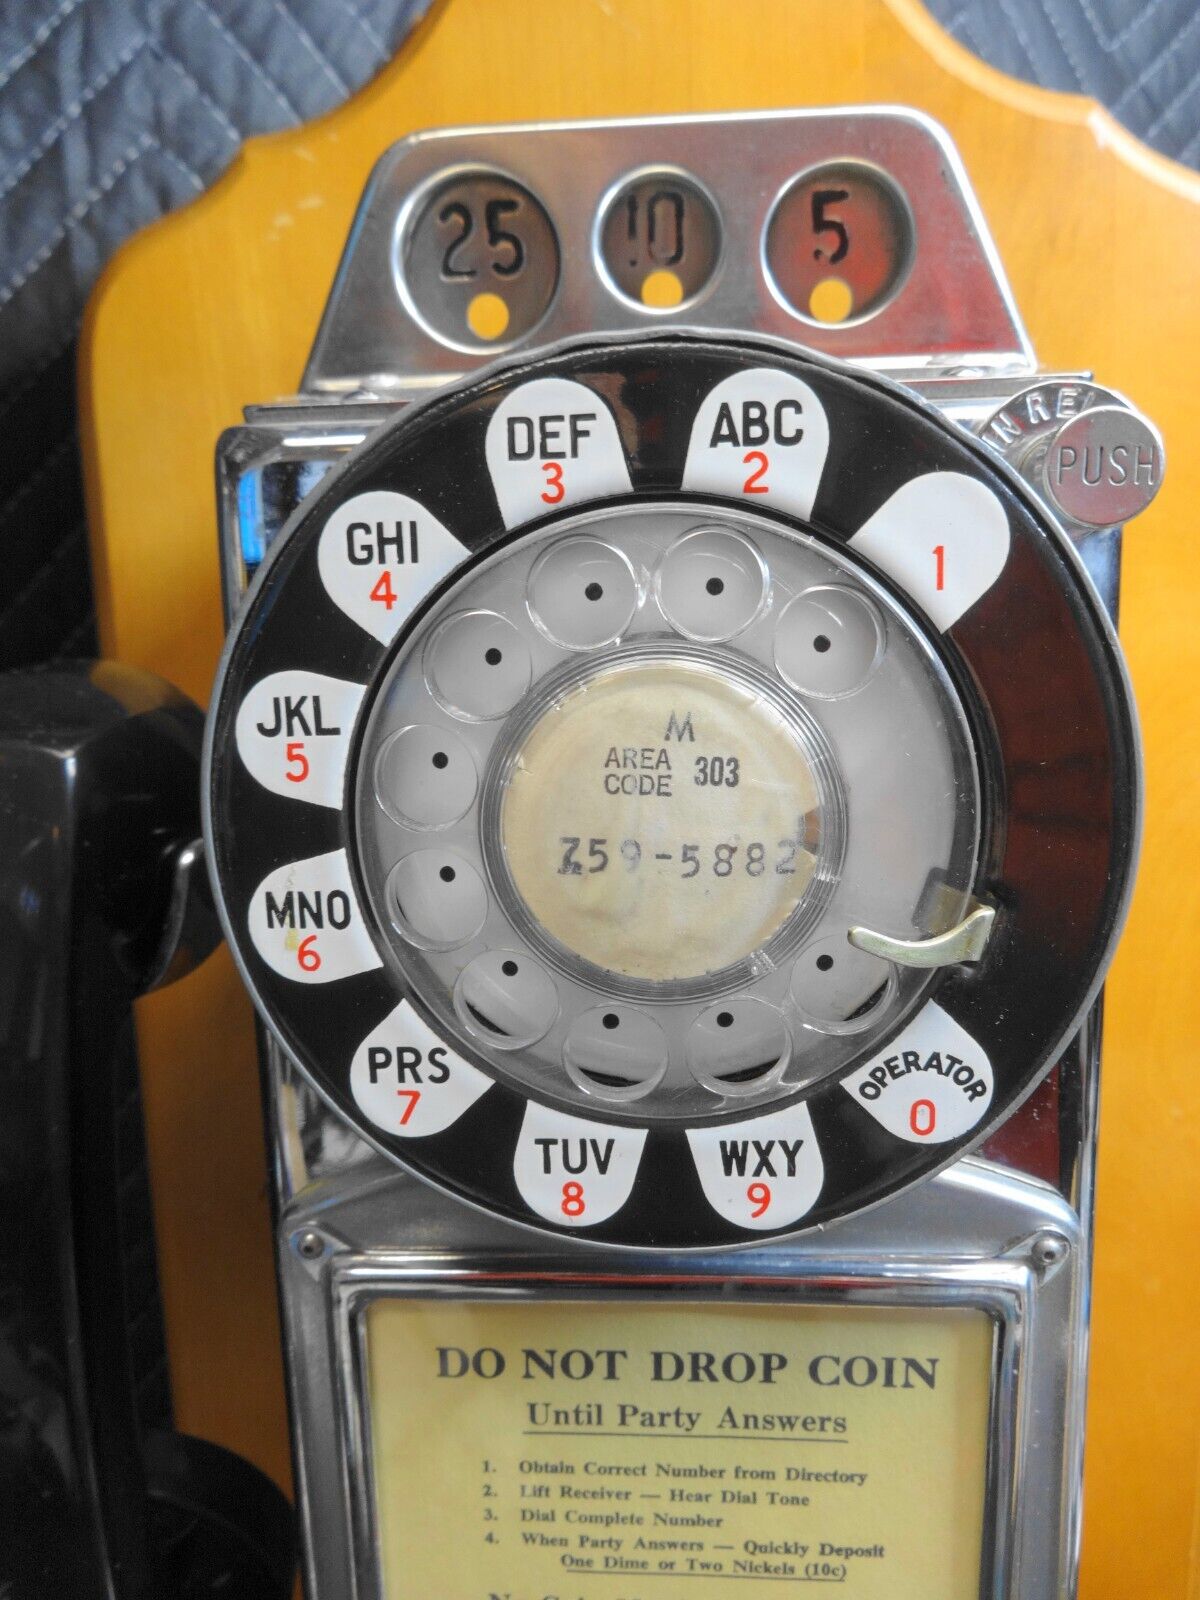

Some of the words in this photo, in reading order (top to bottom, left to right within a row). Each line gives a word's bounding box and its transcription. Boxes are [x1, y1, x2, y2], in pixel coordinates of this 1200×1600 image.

[438, 199, 525, 278] 25
[627, 191, 684, 267] 10
[811, 190, 850, 264] 5
[507, 413, 597, 461] DEF
[709, 399, 804, 448] ABC
[540, 462, 565, 504] 3
[742, 451, 769, 494] 2
[1056, 445, 1155, 486] PUSH
[346, 520, 420, 566] GHI
[931, 545, 945, 591] 1
[369, 571, 398, 611] 4
[257, 695, 341, 738] JKL
[664, 710, 696, 742] M
[285, 742, 310, 783] 5
[604, 746, 672, 771] AREA
[694, 756, 740, 788] 303
[604, 773, 672, 797] CODE
[265, 891, 351, 930] MNO
[297, 935, 322, 972] 6
[368, 1046, 451, 1084] PRS
[858, 1050, 988, 1103] OPERATOR
[396, 1090, 421, 1125] 7
[910, 1098, 936, 1136] 0
[534, 1138, 616, 1176] TUV
[719, 1139, 804, 1178] WXY
[561, 1182, 586, 1217] 8
[746, 1182, 771, 1218] 9
[436, 1347, 506, 1379] DO
[521, 1349, 628, 1381] NOT
[651, 1351, 788, 1384] DROP
[808, 1355, 940, 1390] COIN
[527, 1402, 603, 1426] Until
[617, 1404, 702, 1431] Party
[716, 1406, 847, 1434] Answers
[482, 1460, 497, 1473] 1.
[519, 1460, 575, 1475] Obtain
[583, 1461, 647, 1477] Correct
[655, 1463, 726, 1479] Number
[733, 1465, 776, 1481] from
[785, 1467, 868, 1487] Directory
[482, 1484, 498, 1497] 2.
[519, 1484, 550, 1498] Lift
[559, 1485, 632, 1500] Receiver
[670, 1488, 713, 1503] Hear
[721, 1489, 757, 1504] Dial
[766, 1491, 810, 1507] Tone
[483, 1508, 498, 1521] 3.
[520, 1508, 556, 1522] Dial
[565, 1509, 644, 1527] Complete
[653, 1512, 723, 1528] Number
[484, 1532, 499, 1544] 4.
[521, 1532, 569, 1547] When
[578, 1534, 623, 1551] Party
[633, 1536, 704, 1551] Answers
[744, 1540, 809, 1558] Quickly
[819, 1542, 885, 1560] Deposit
[560, 1554, 594, 1569] One
[603, 1555, 649, 1570] Dime
[658, 1559, 676, 1571] or
[686, 1558, 723, 1573] Two
[733, 1559, 795, 1576] Nickels
[804, 1562, 847, 1580] (10c)
